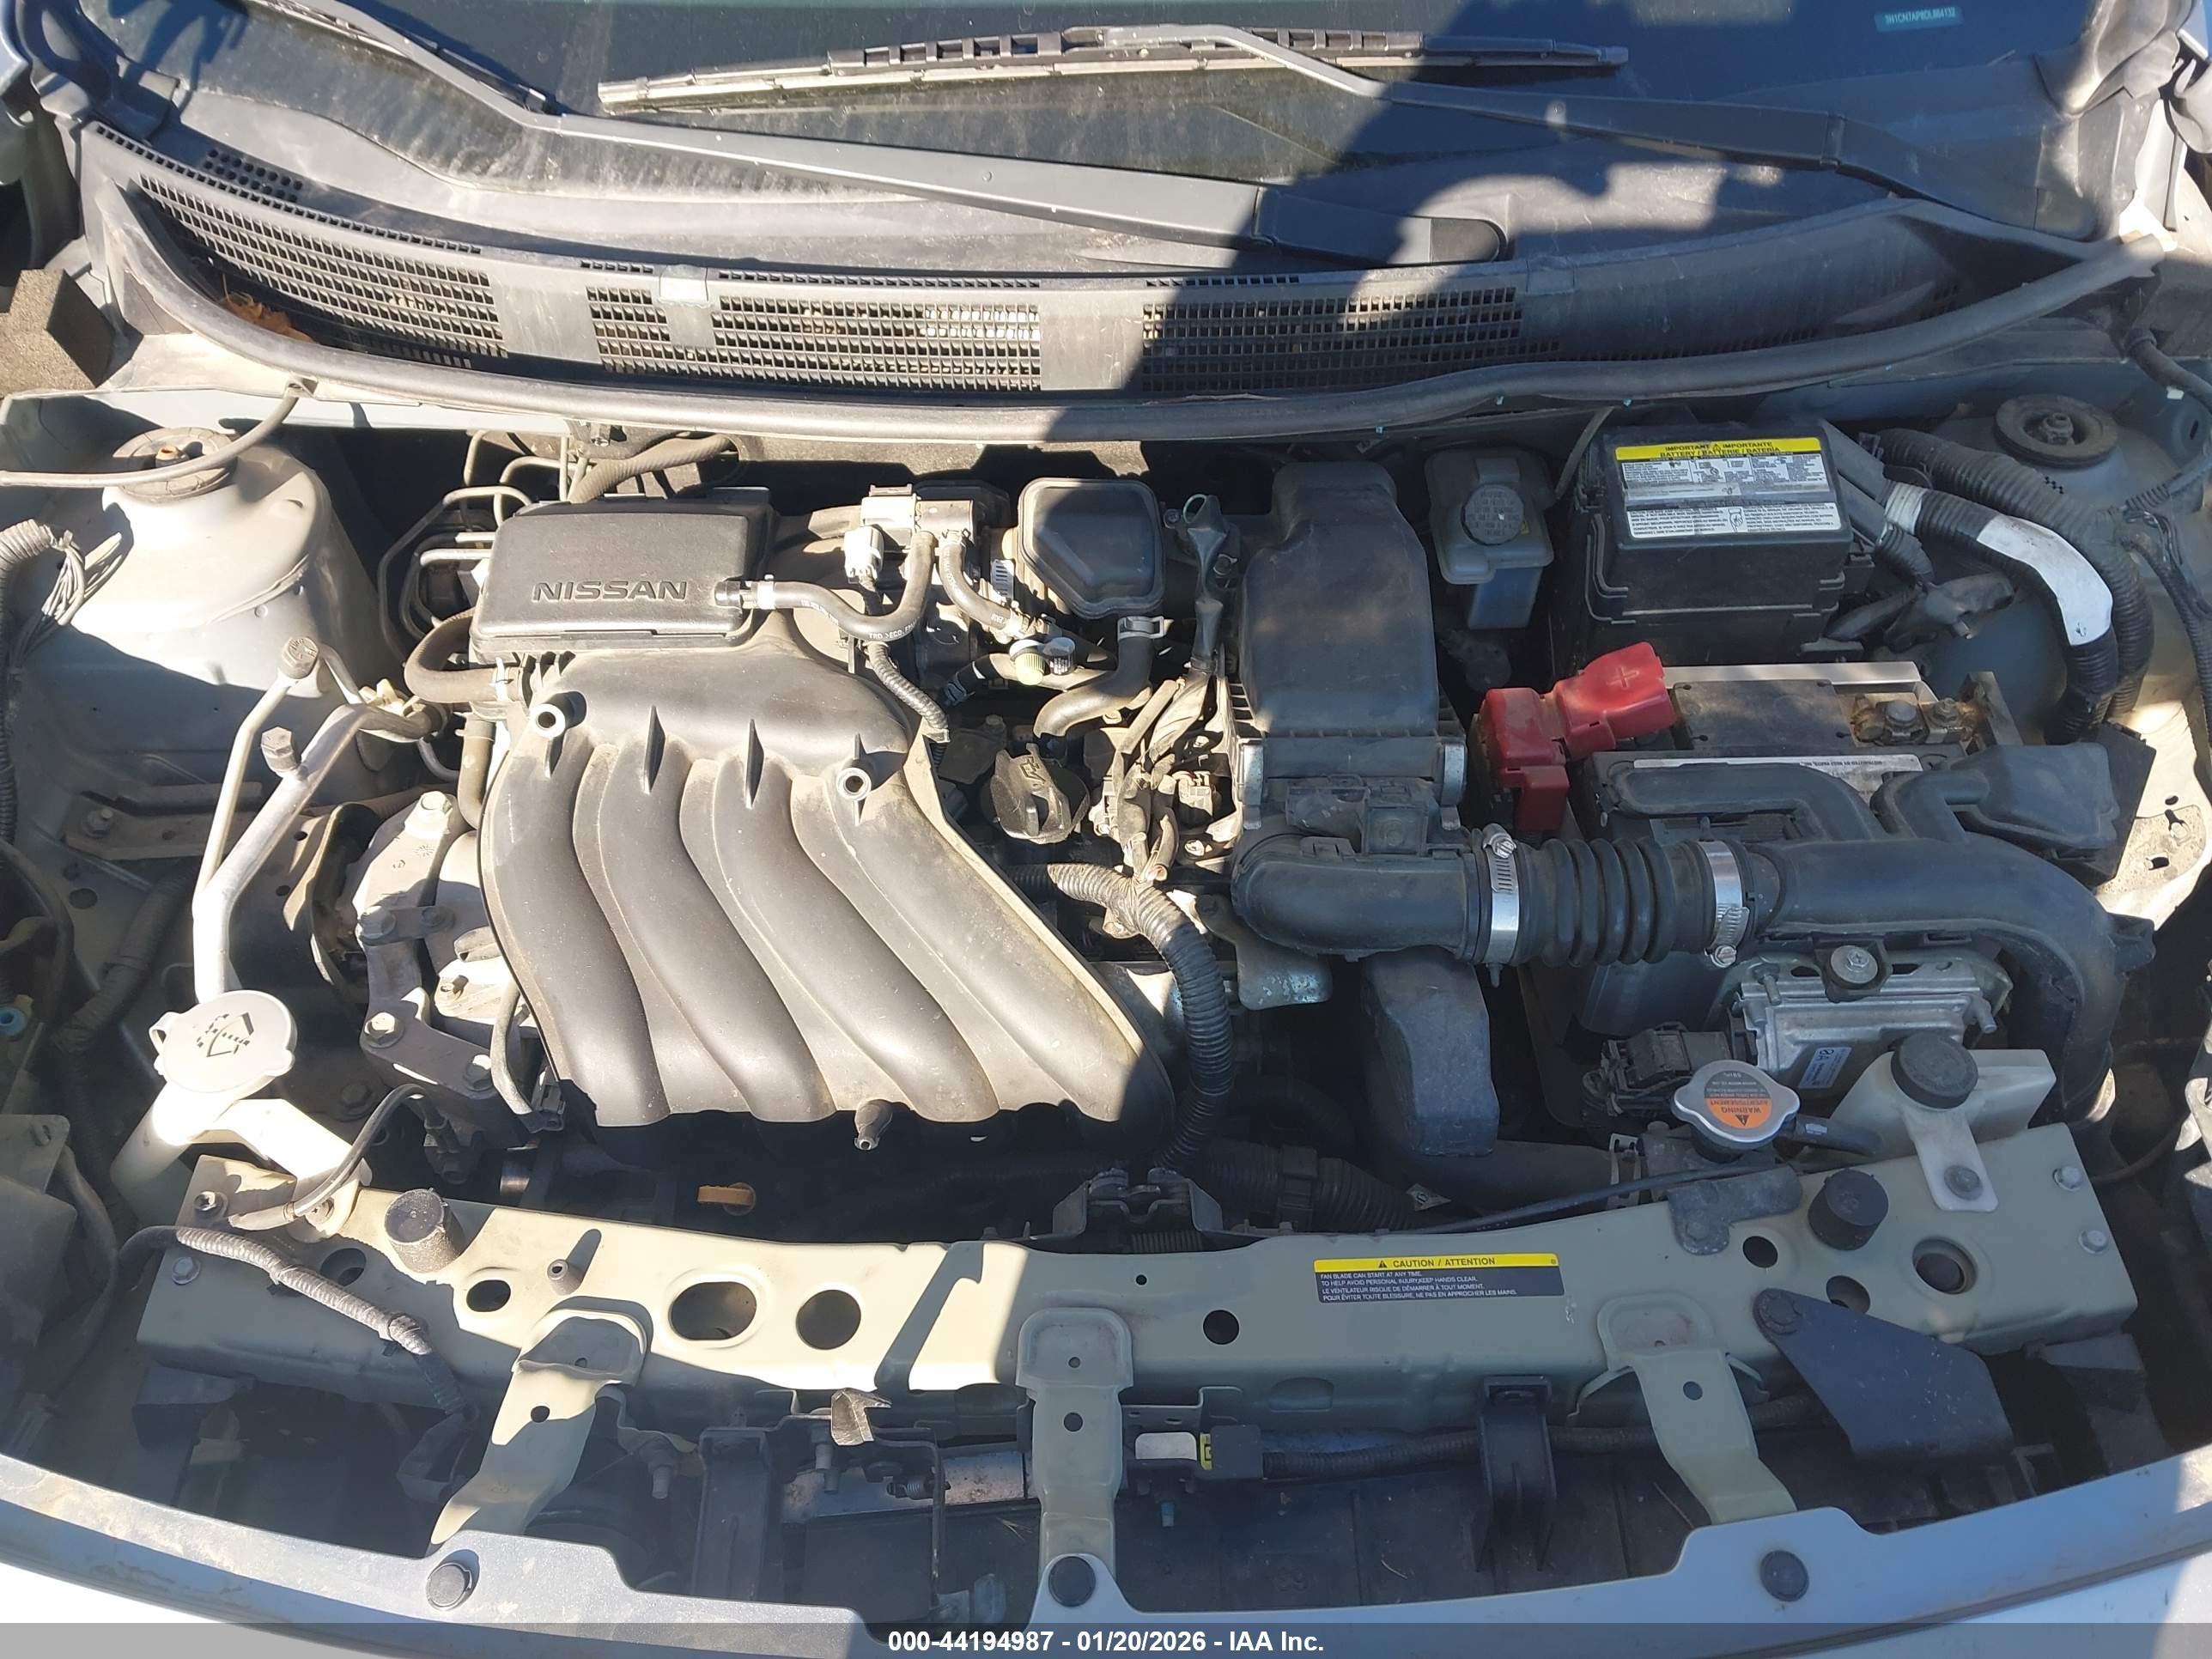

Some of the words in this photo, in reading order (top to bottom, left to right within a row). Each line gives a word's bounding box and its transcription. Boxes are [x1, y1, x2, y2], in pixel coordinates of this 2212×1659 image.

[532, 580, 687, 602] NISSAN
[1393, 1259, 1434, 1268] CAUTION
[1445, 1257, 1496, 1267] ATTENTION
